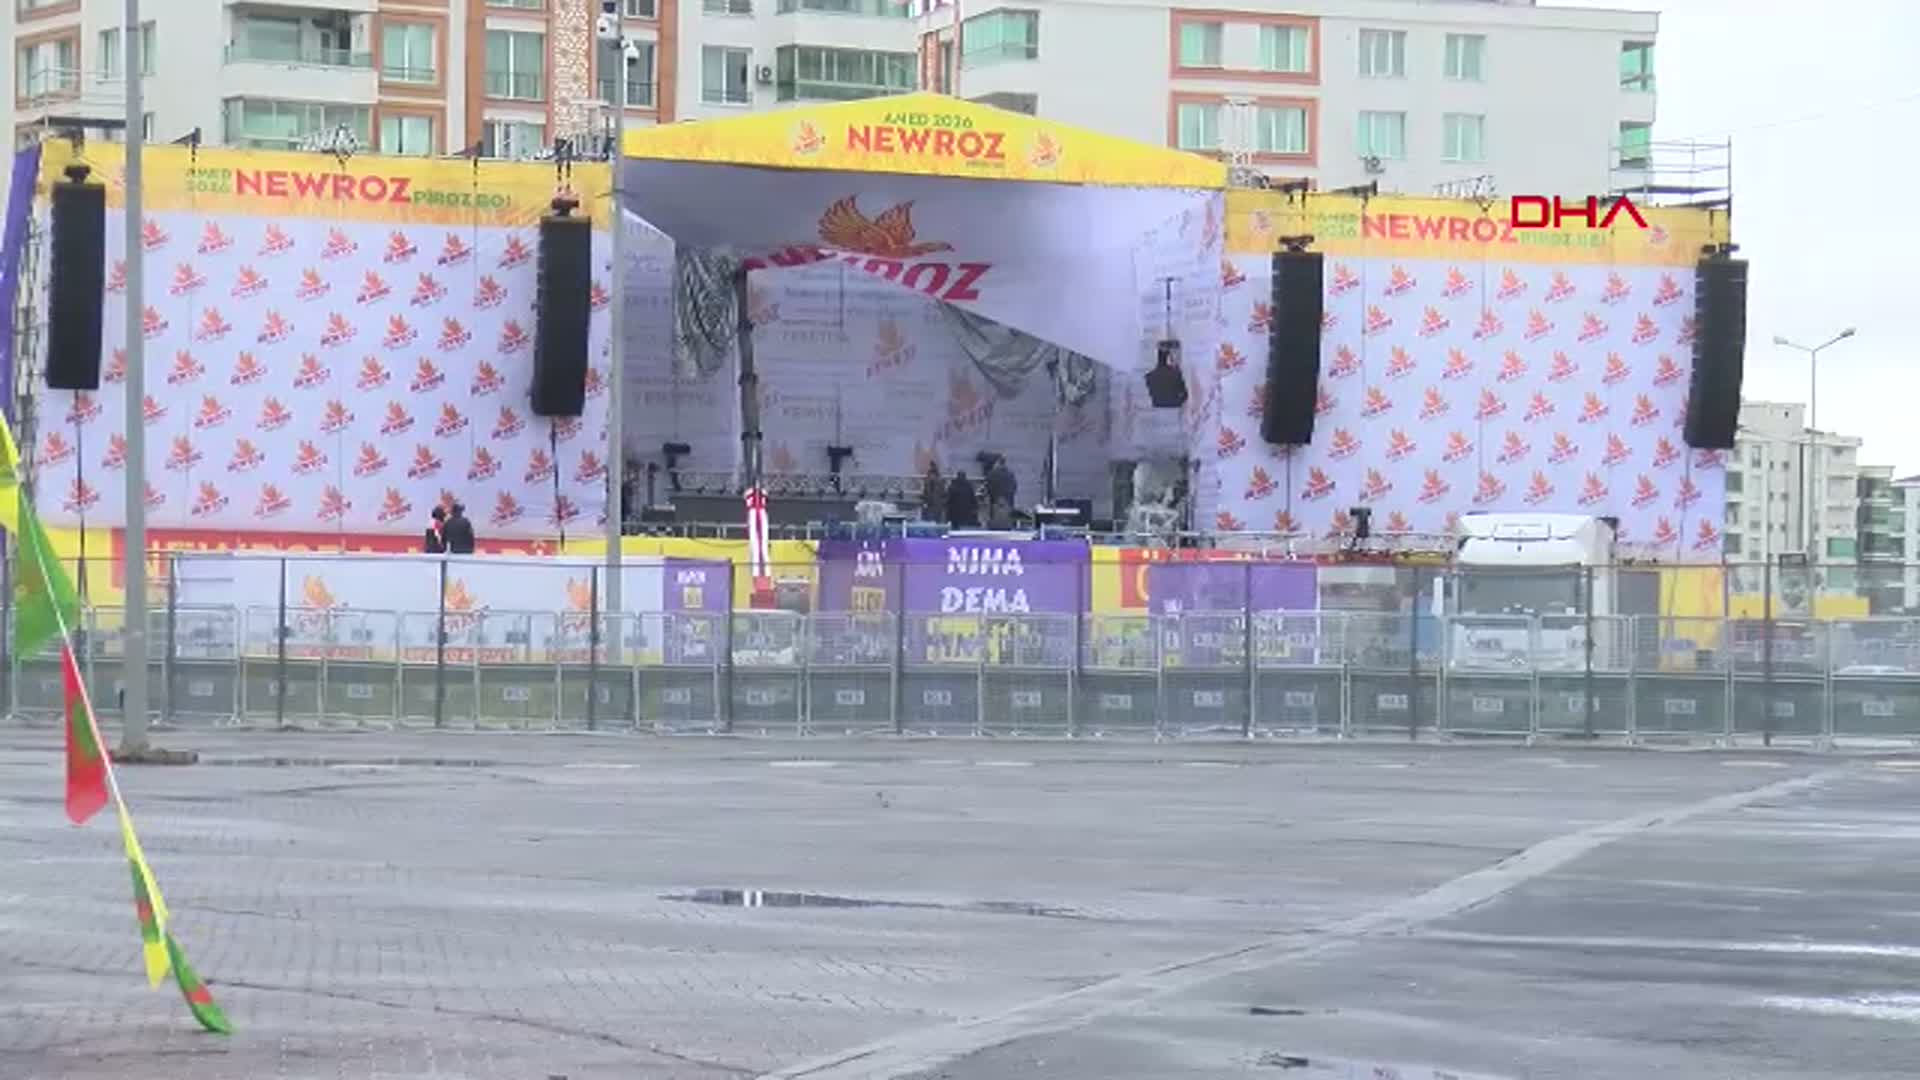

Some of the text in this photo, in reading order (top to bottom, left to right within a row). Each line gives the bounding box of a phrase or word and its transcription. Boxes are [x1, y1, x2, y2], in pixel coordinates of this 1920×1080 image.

[847, 124, 1005, 161] NEWROZ
[235, 168, 411, 203] NEWROZ
[1361, 212, 1519, 245] NEWROZ
[940, 586, 1030, 613] DEMA
